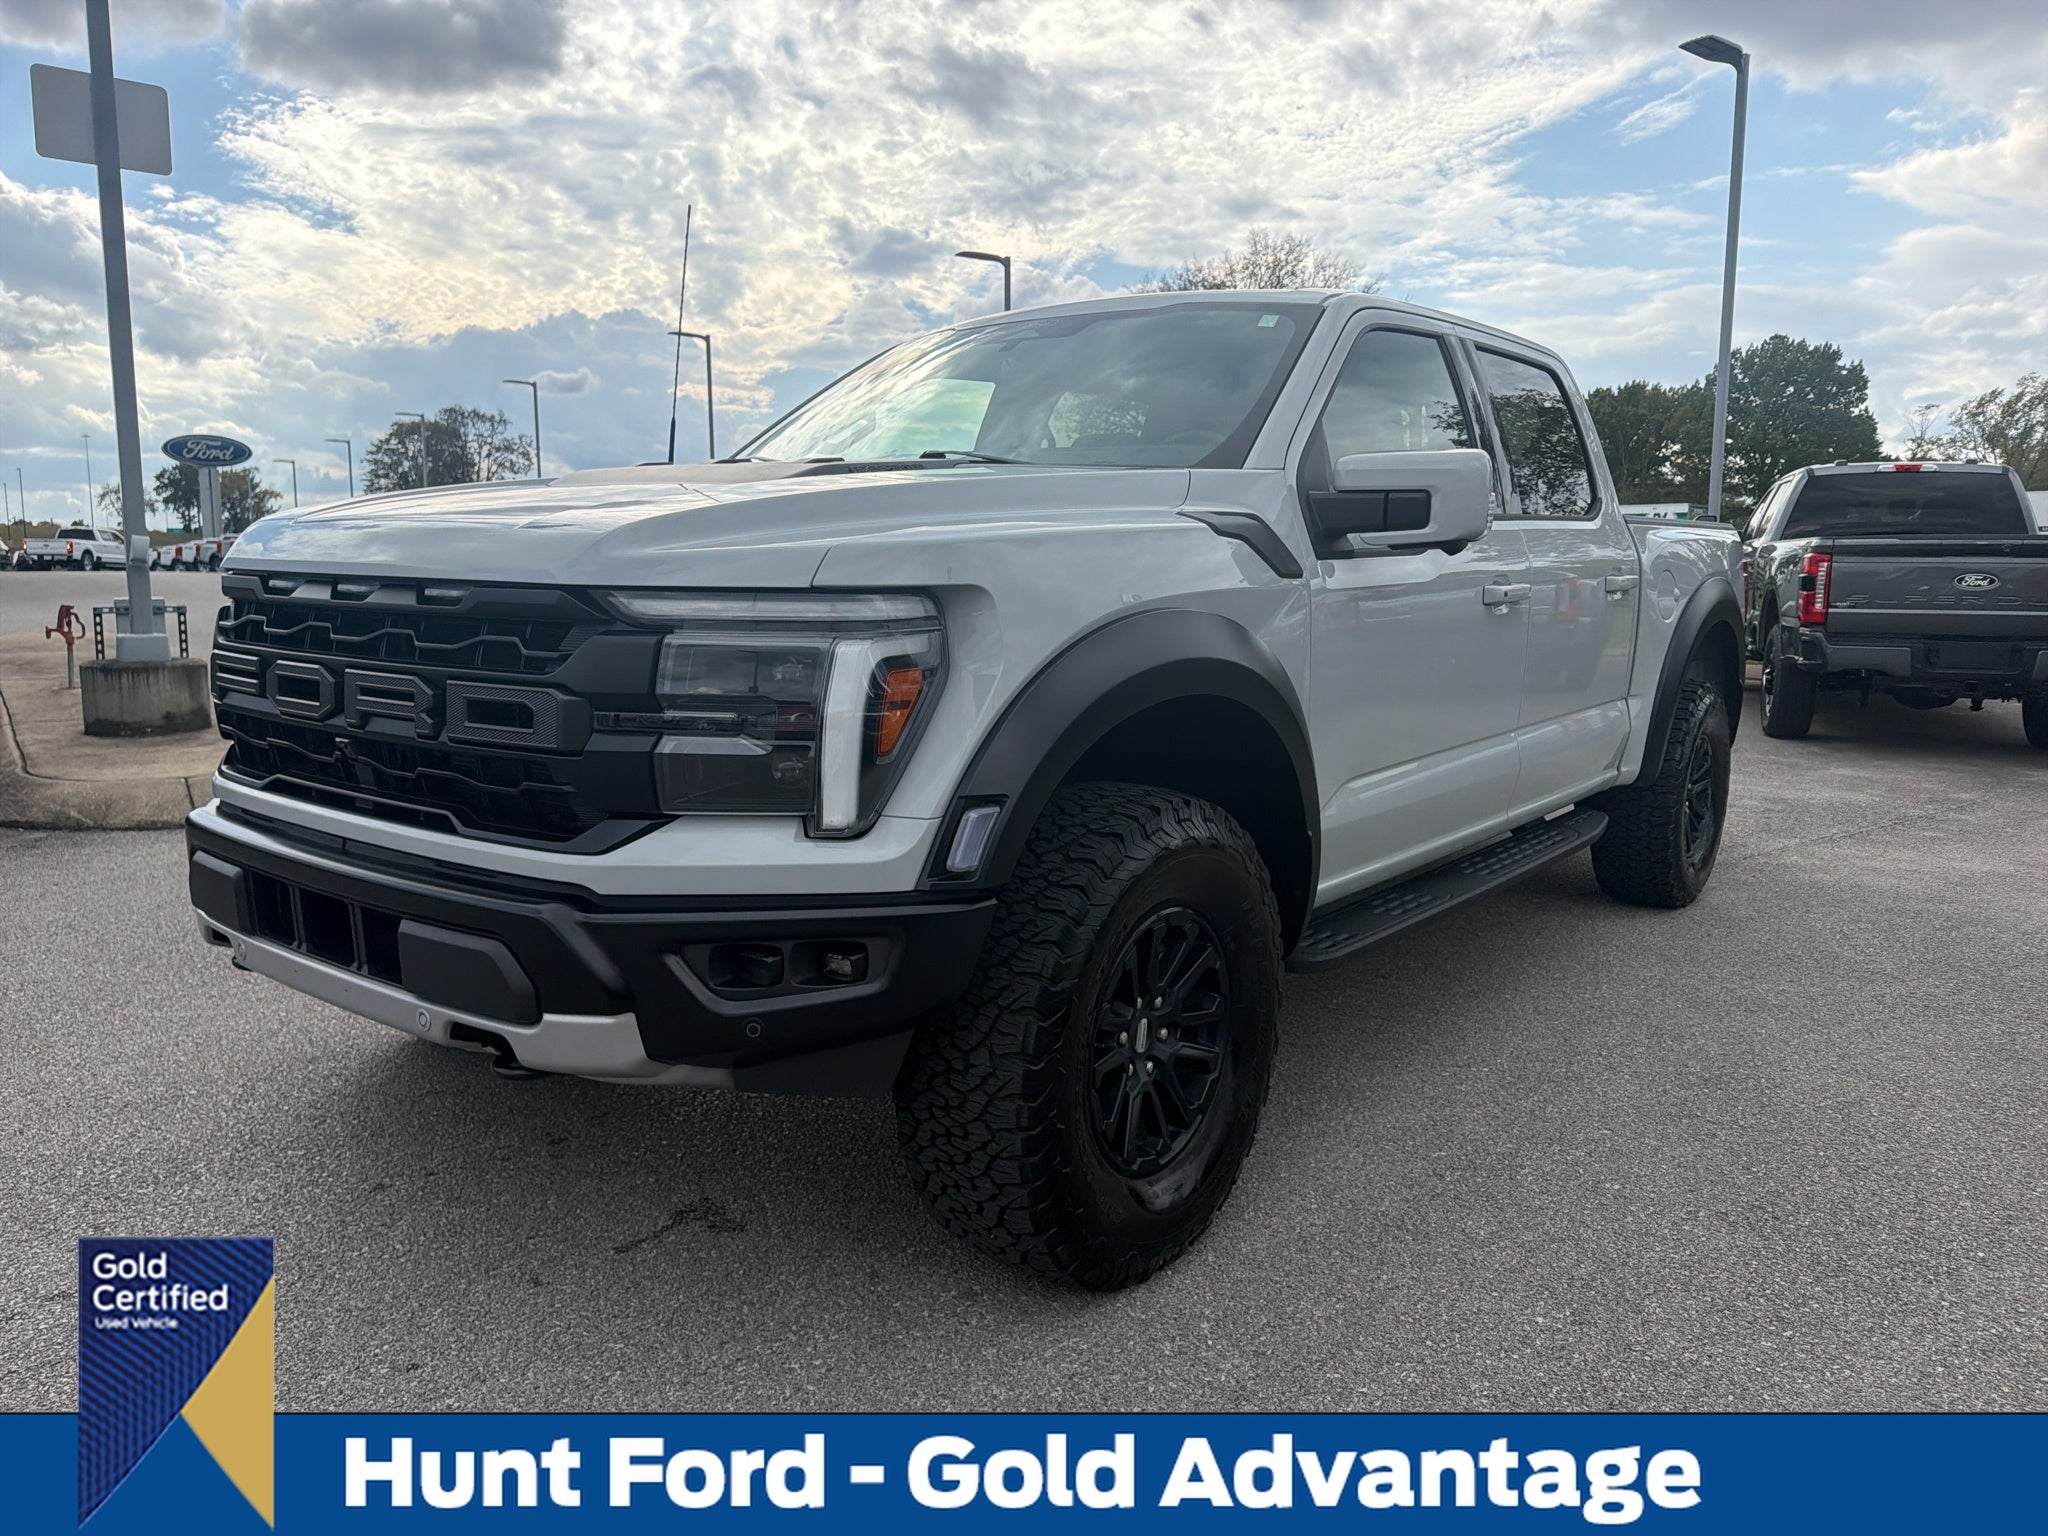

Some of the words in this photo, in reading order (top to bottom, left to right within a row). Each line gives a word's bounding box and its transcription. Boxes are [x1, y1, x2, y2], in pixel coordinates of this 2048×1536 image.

[183, 440, 234, 460] Ford
[1962, 575, 1990, 586] Ford
[211, 649, 590, 752] FORD
